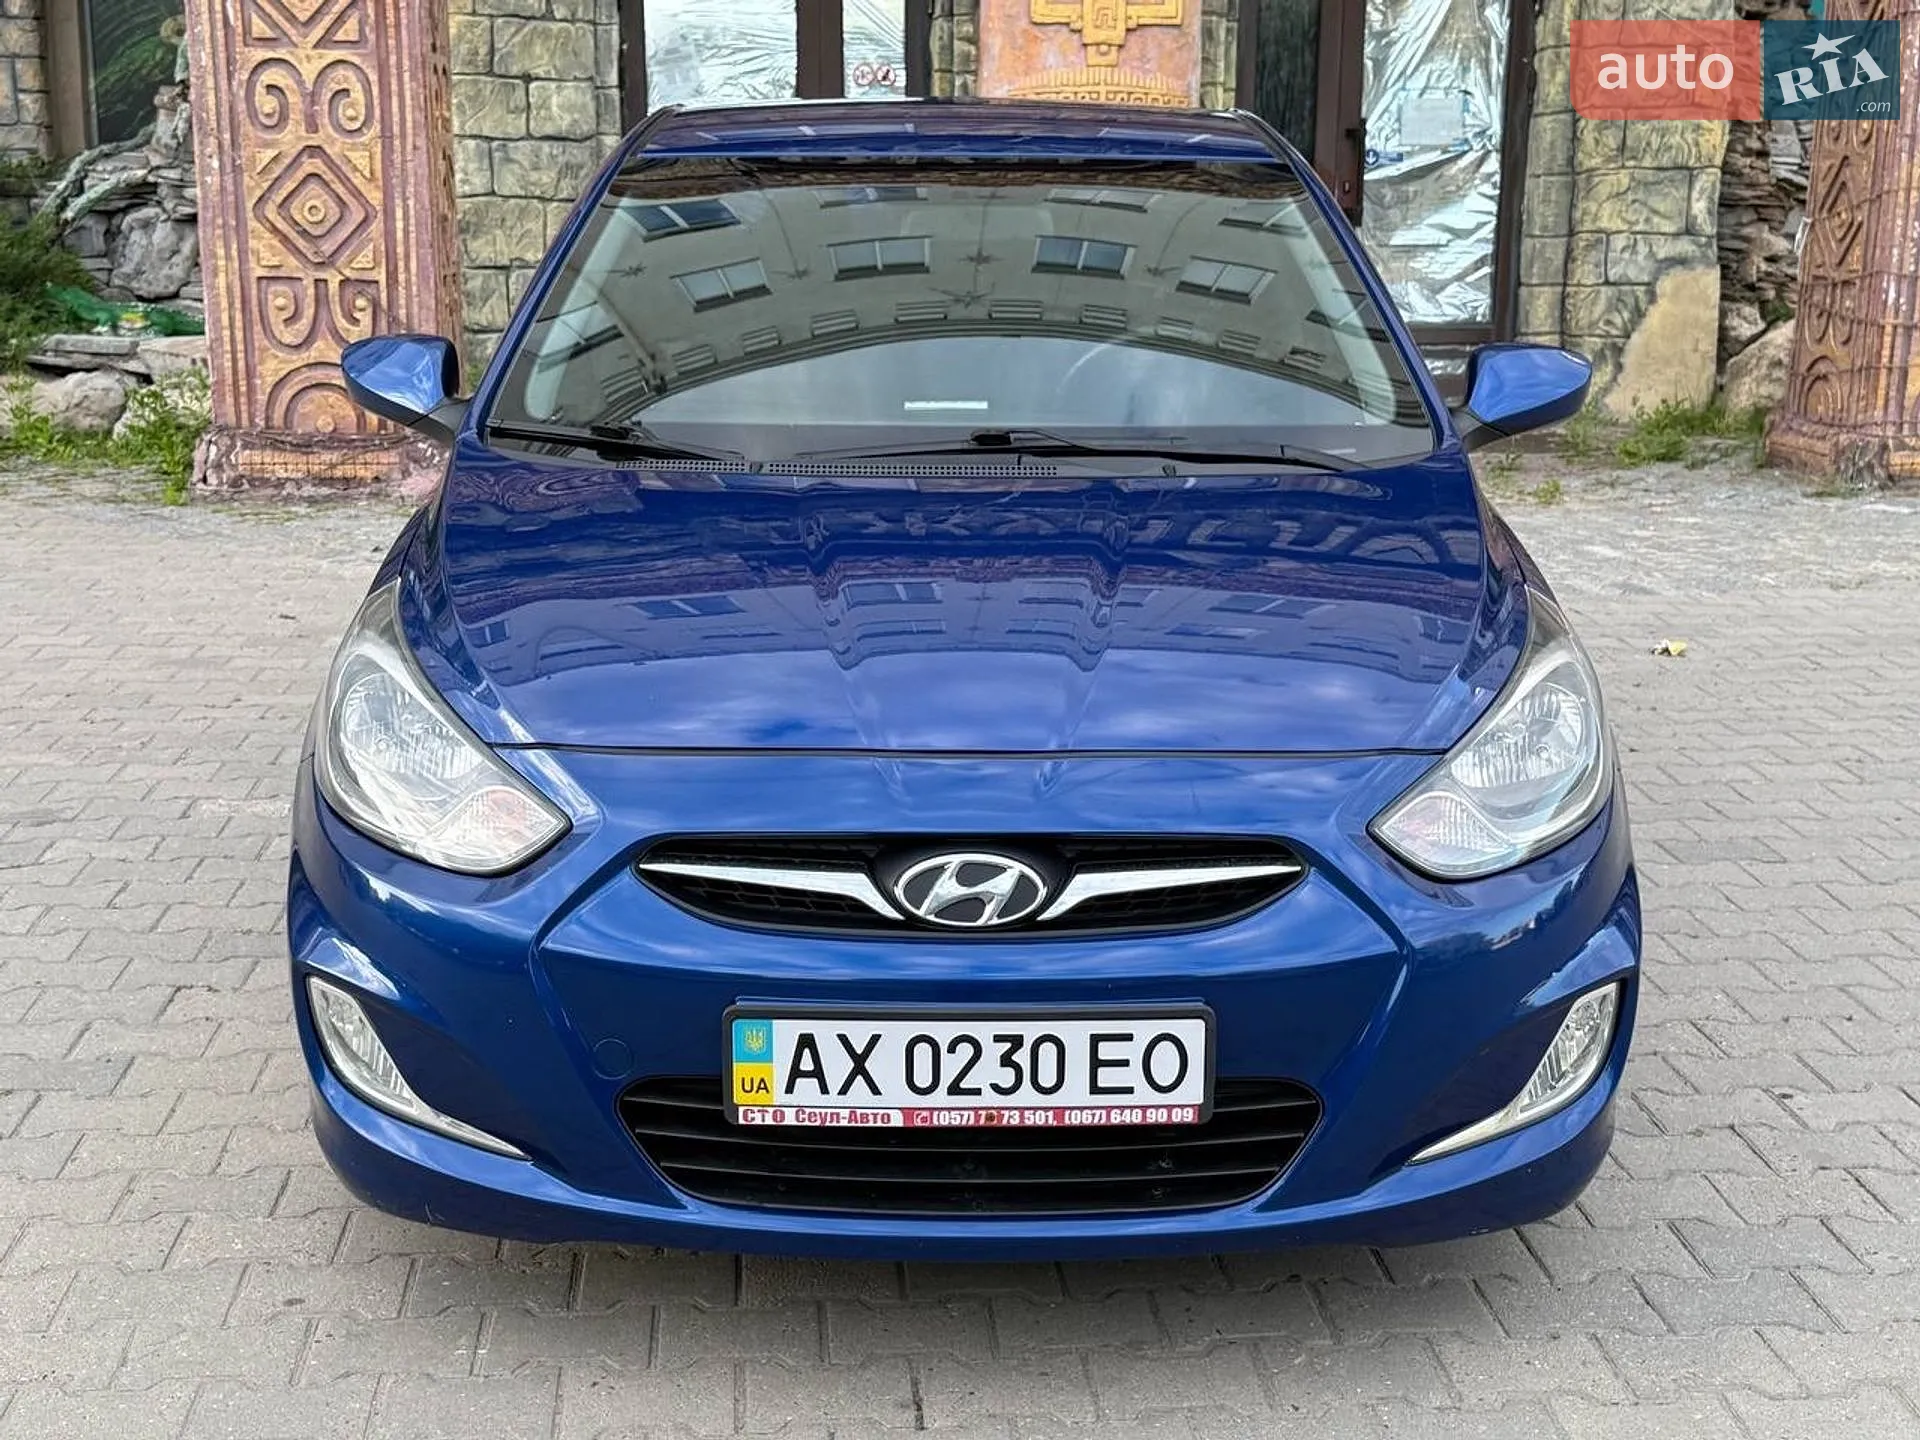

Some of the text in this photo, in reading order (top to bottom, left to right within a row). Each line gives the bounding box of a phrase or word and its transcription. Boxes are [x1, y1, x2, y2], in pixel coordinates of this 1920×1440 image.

[784, 1032, 1189, 1096] AX 0230 EO
[741, 1077, 770, 1094] UA
[742, 1108, 786, 1125] СТО
[794, 1108, 892, 1126] Сеул-Авто
[933, 1110, 974, 1126] (057)
[978, 1110, 997, 1125] 7
[1064, 1109, 1107, 1125] (067)
[1146, 1108, 1168, 1123] 90
[1172, 1107, 1194, 1122] 09
